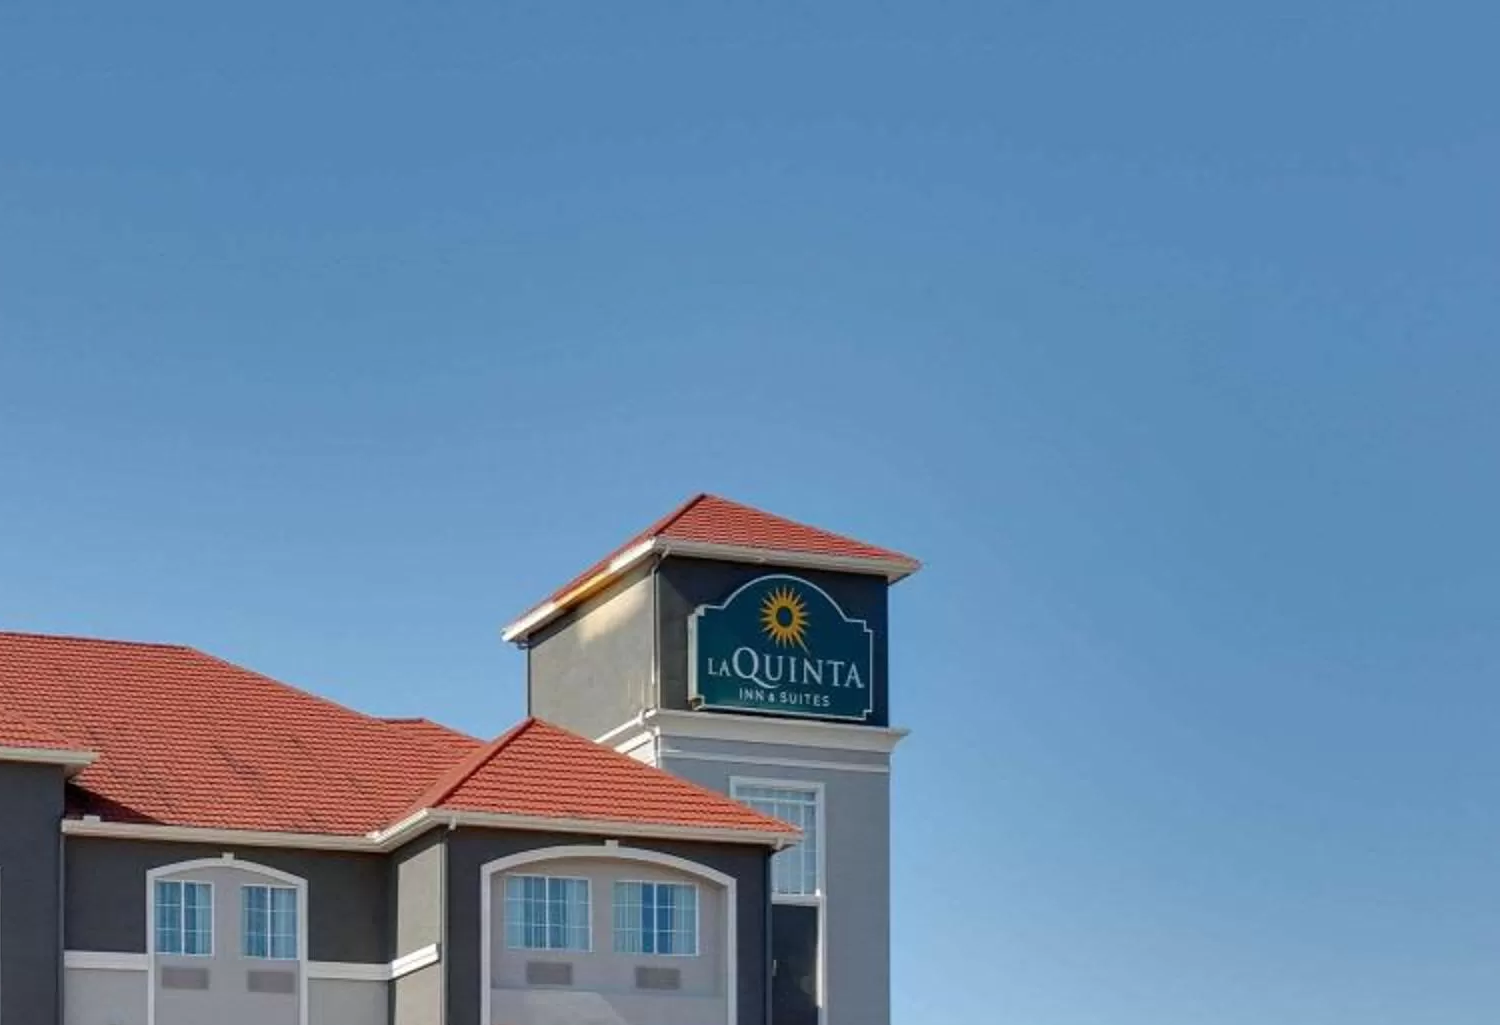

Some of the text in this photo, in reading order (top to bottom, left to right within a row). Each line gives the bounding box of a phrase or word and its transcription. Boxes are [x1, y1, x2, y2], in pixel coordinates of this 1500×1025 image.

[708, 647, 865, 689] LA QUINTA
[739, 688, 764, 701] INN
[779, 691, 831, 707] SUITES
